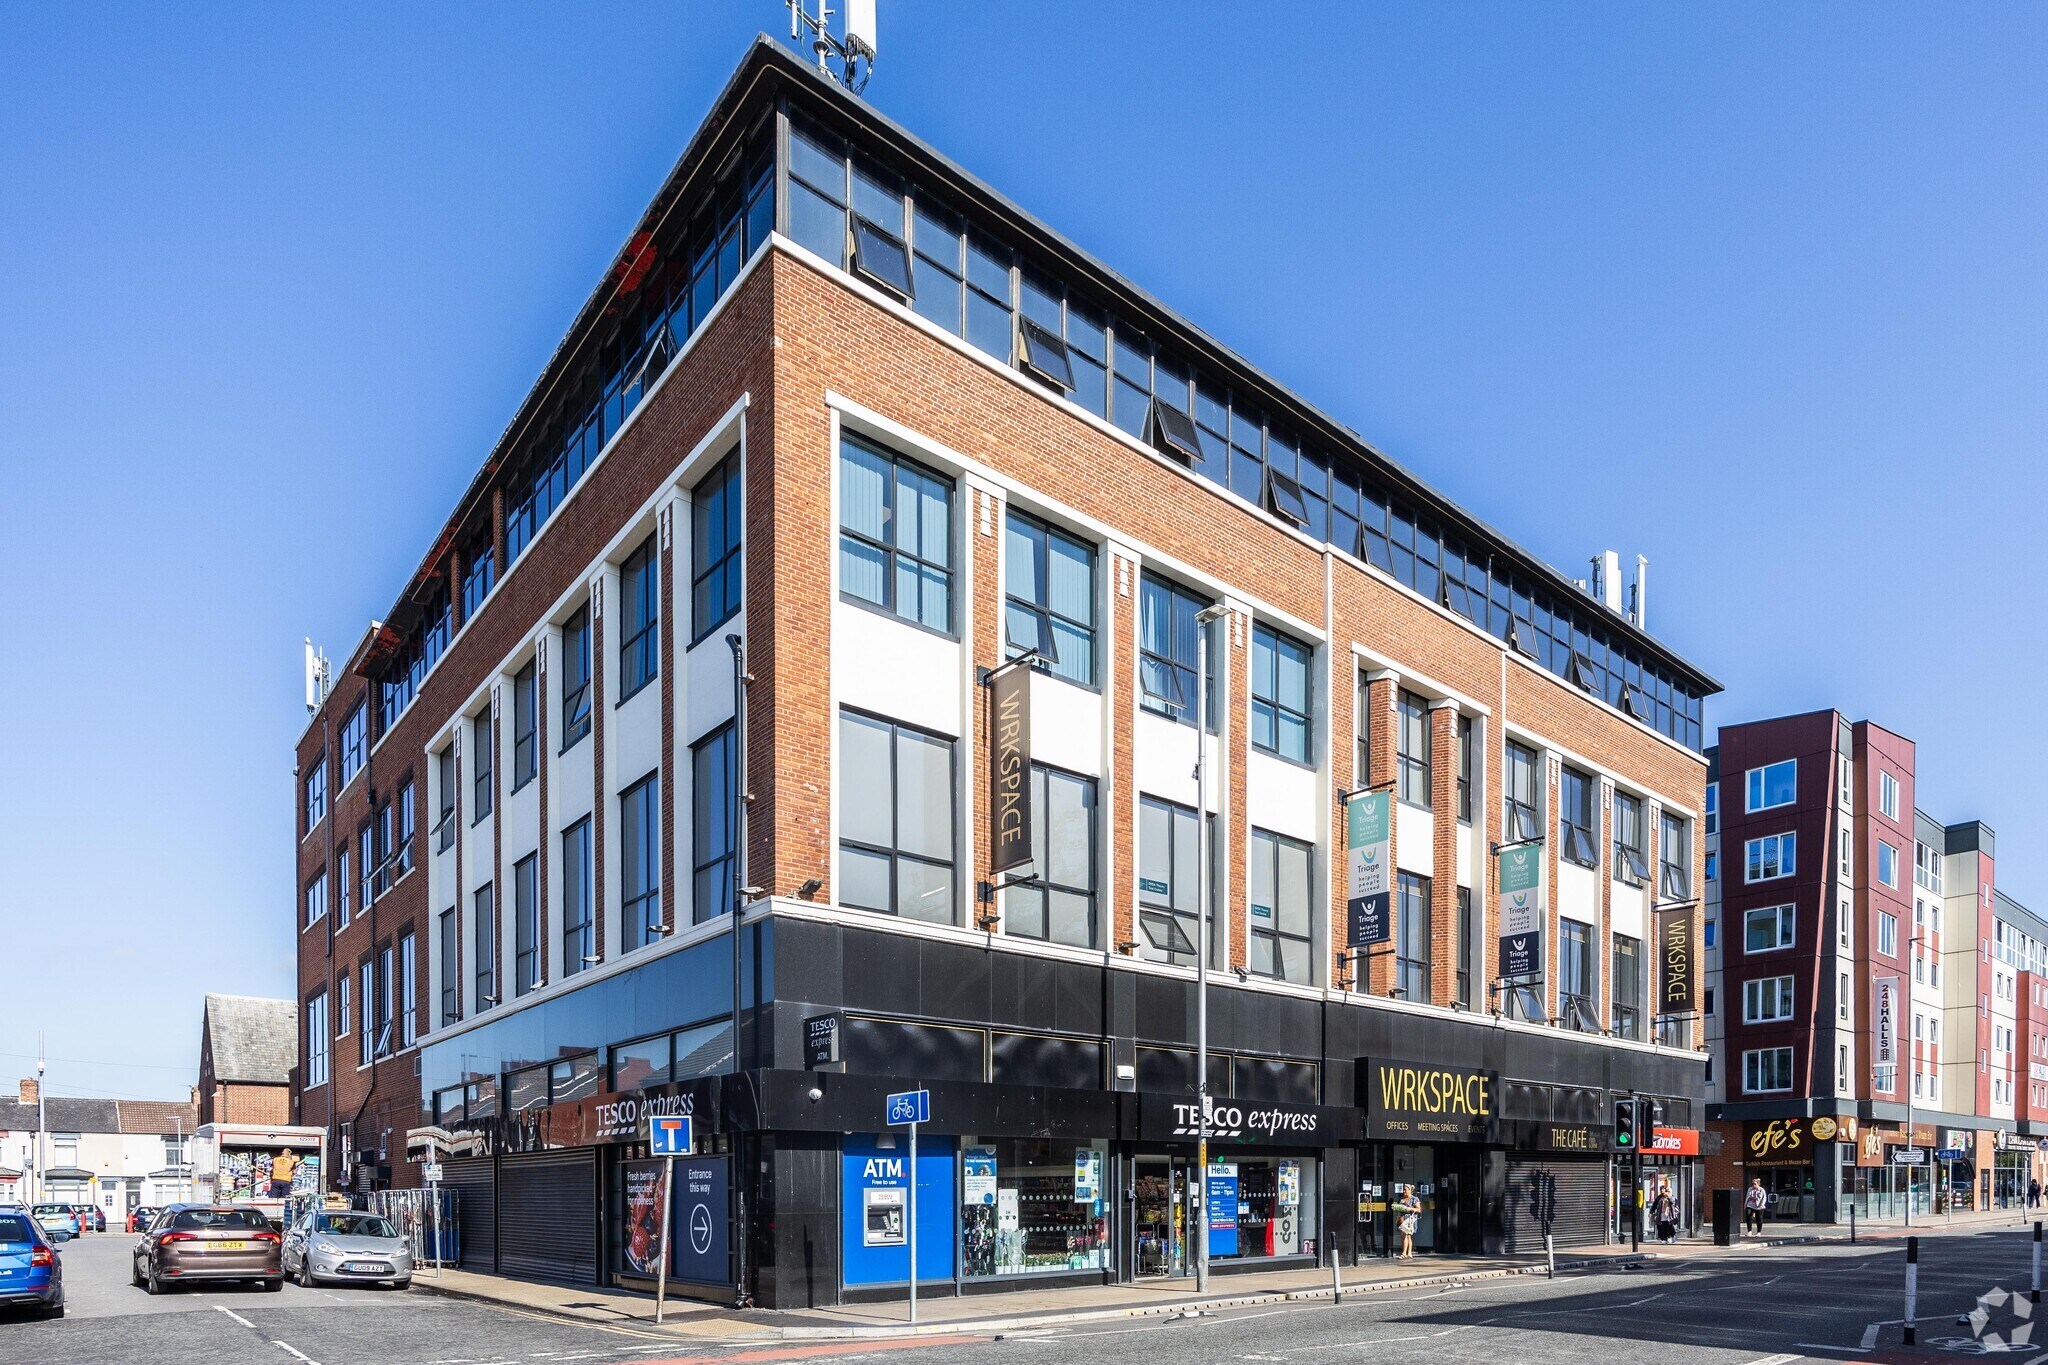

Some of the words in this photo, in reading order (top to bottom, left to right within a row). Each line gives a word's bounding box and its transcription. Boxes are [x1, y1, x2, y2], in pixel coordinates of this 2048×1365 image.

[1000, 689, 1021, 847] WRKSPACE
[1358, 814, 1378, 824] Triage
[1358, 864, 1380, 873] Triage
[1358, 874, 1380, 882] helping
[1358, 880, 1380, 888] people
[1508, 906, 1530, 915] Triage
[1358, 914, 1378, 923] Triage
[1360, 929, 1378, 937] people
[1668, 919, 1686, 1002] WRKSPACE
[810, 1018, 836, 1032] TESCO
[811, 1036, 834, 1048] express
[1380, 1066, 1489, 1116] WRKSPACE
[596, 1100, 636, 1126] TESCO
[640, 1092, 694, 1121] express
[1248, 1108, 1316, 1136] express
[1386, 1121, 1408, 1130] OFFICES
[1418, 1122, 1440, 1132] MEETING
[1441, 1123, 1458, 1132] SPACES
[1468, 1126, 1486, 1134] EVENTS
[1552, 1128, 1566, 1148] THE
[1567, 1126, 1587, 1148] CAFÉ
[1750, 1120, 1802, 1158] efe's
[627, 1171, 639, 1180] Fresh
[640, 1170, 656, 1180] berries
[688, 1169, 712, 1180] Entrance
[1211, 1166, 1230, 1174] Hello.
[627, 1184, 652, 1194] handpicked
[690, 1182, 699, 1192] this
[700, 1184, 710, 1195] way
